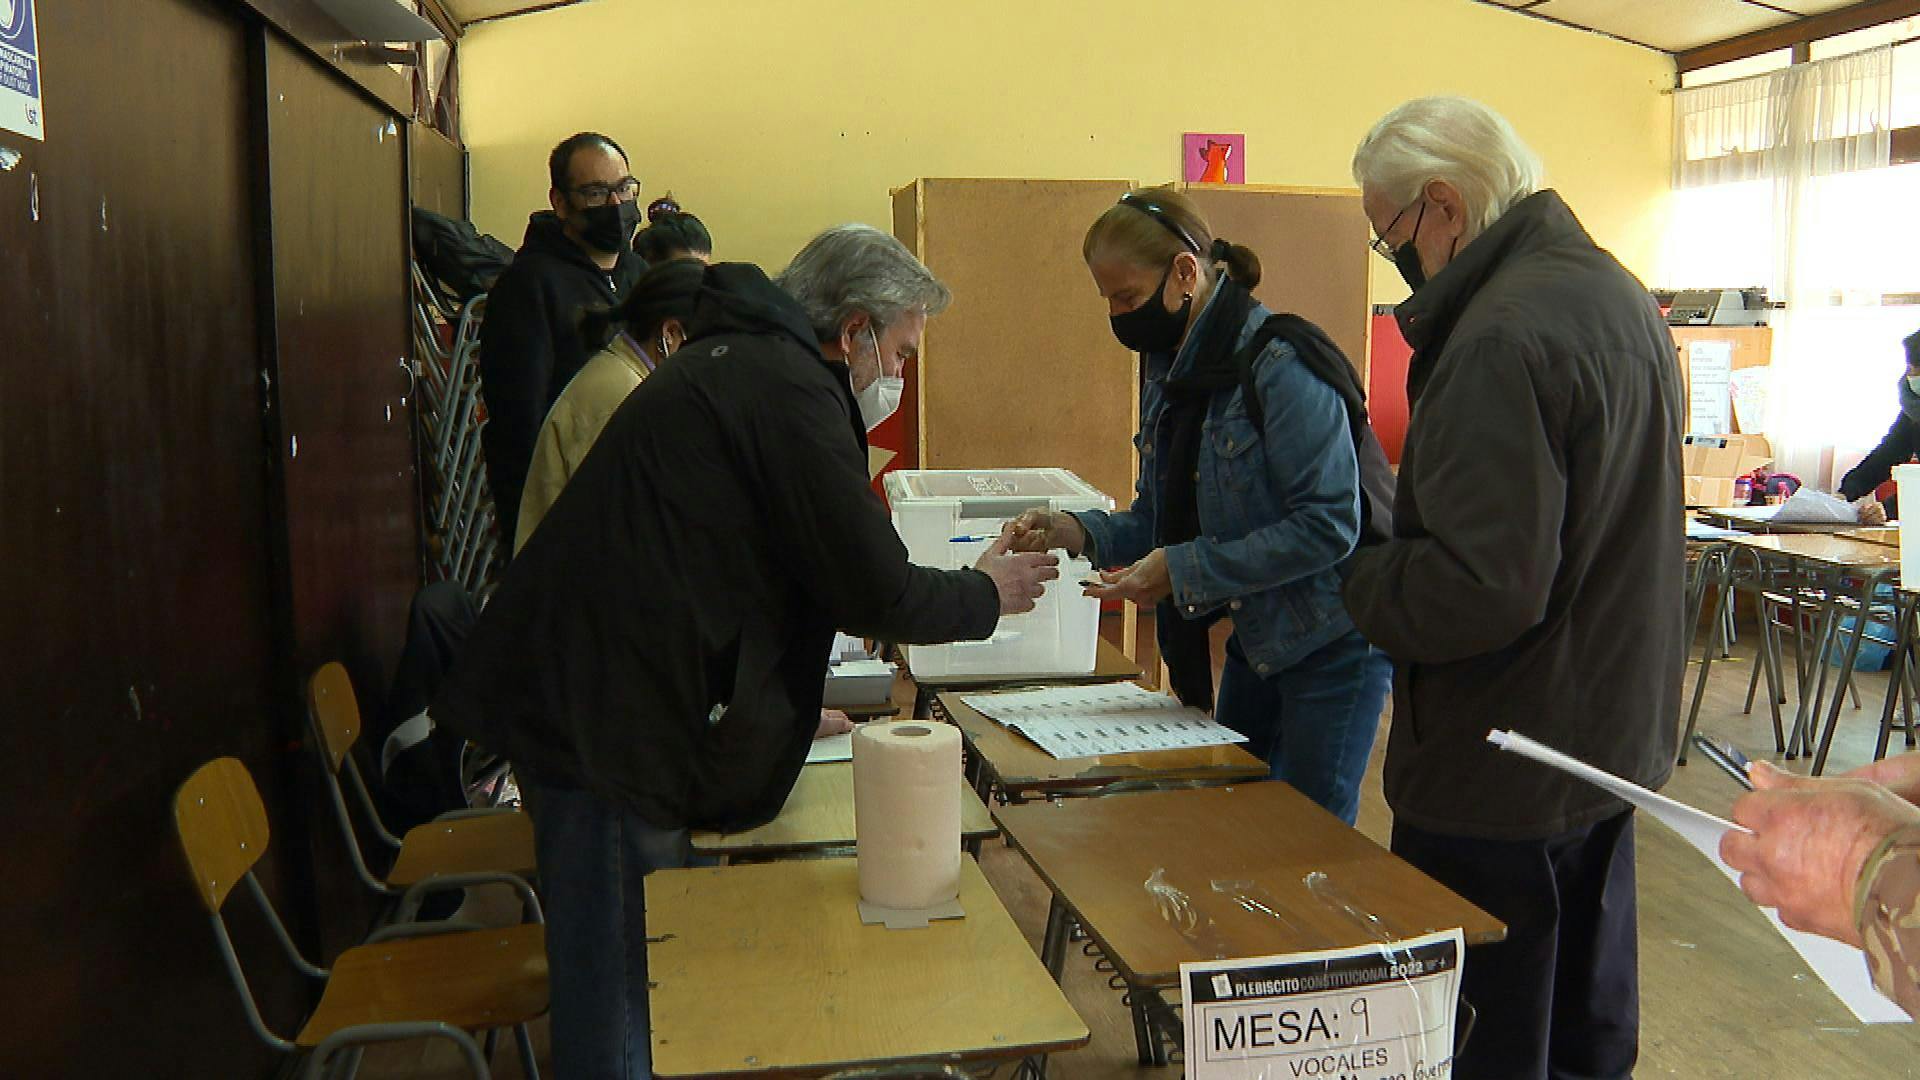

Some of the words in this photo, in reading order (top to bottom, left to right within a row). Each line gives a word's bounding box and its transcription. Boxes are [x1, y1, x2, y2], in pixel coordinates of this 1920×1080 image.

[1235, 977, 1300, 997] PLEBISCITO
[1300, 966, 1389, 991] CONSTITUCIONAL
[1390, 960, 1424, 978] 2022
[1214, 1007, 1339, 1051] MESA:
[1350, 997, 1371, 1037] 9
[1290, 1047, 1388, 1078] VOCALES
